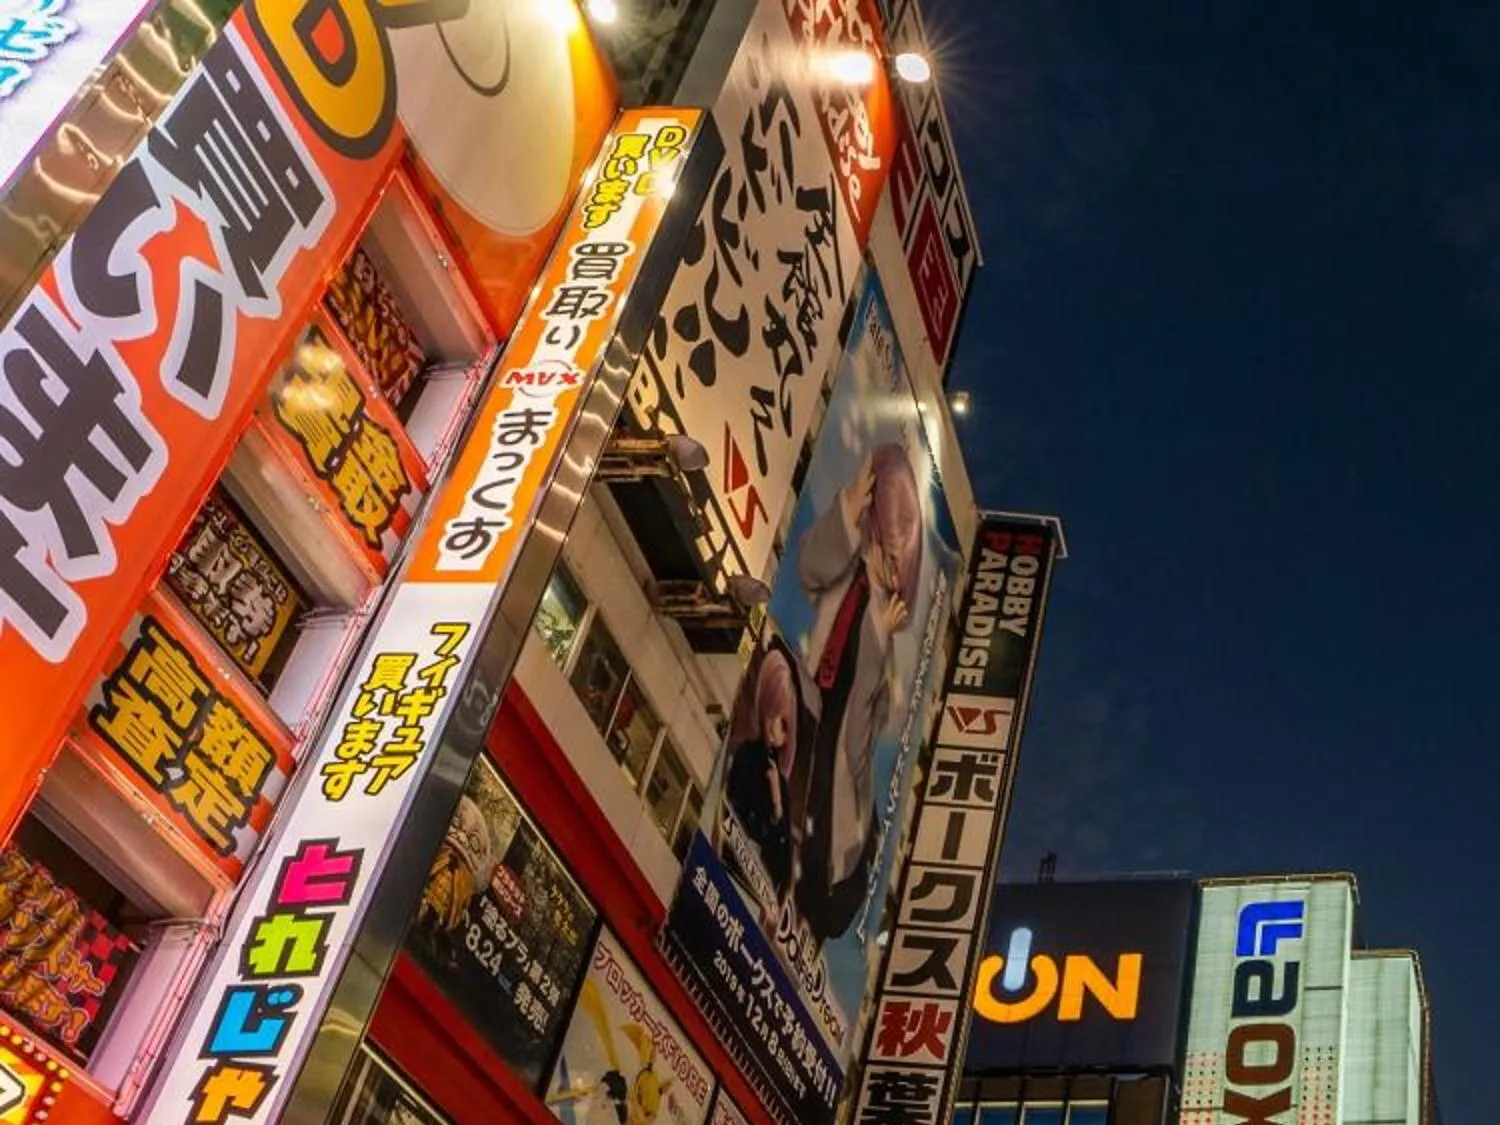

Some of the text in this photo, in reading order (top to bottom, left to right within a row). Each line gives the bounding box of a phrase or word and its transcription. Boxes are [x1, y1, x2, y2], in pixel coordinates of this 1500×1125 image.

[546, 241, 629, 351] 買取り
[440, 407, 548, 563] まっくす
[321, 653, 417, 801] 買います
[365, 622, 472, 795] フィギュア
